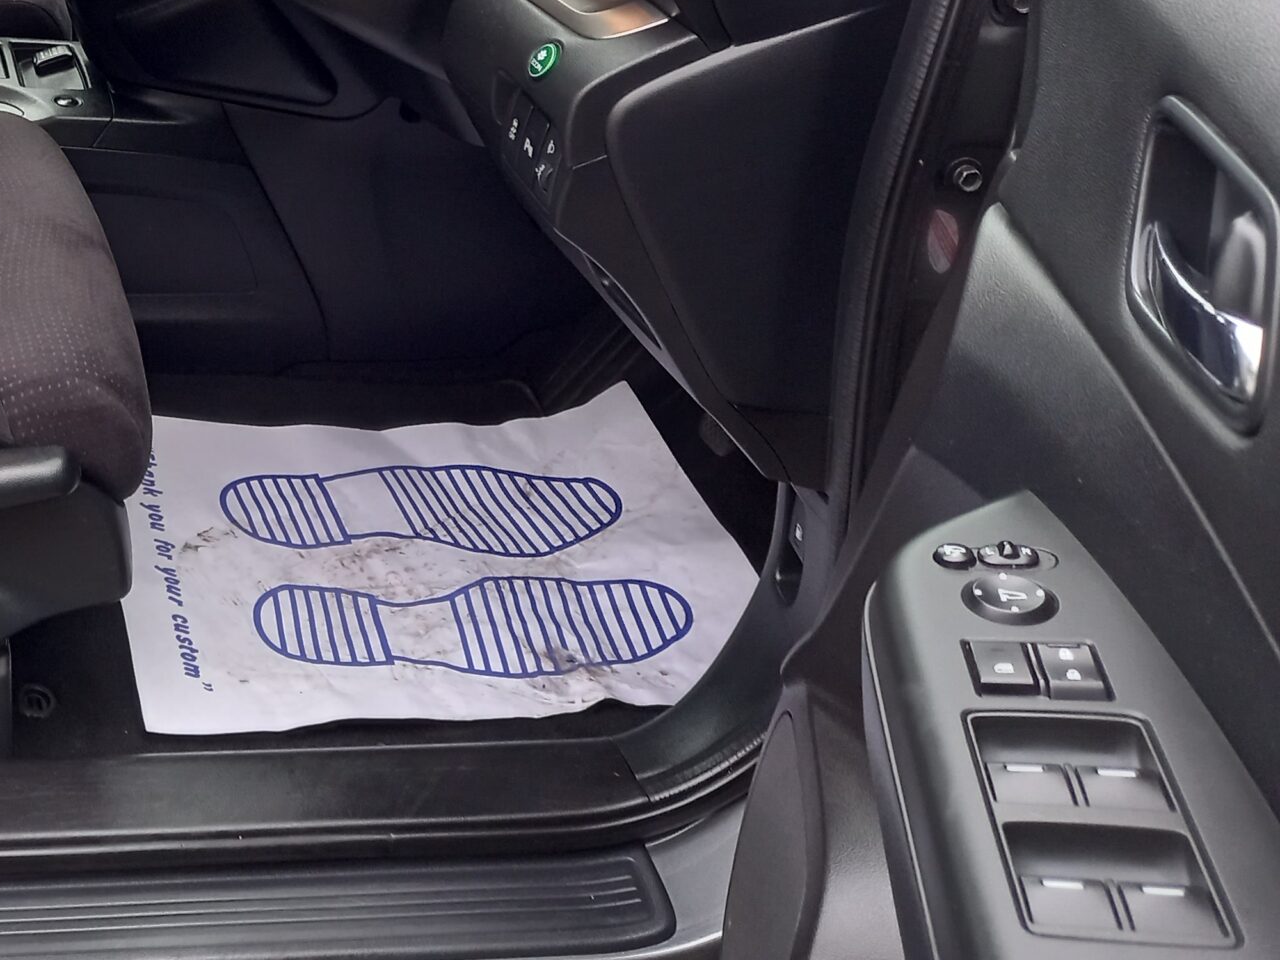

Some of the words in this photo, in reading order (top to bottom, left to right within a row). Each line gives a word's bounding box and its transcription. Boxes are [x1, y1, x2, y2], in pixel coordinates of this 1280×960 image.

[139, 501, 165, 531] you
[153, 538, 176, 560] for
[154, 564, 183, 607] your
[171, 613, 201, 678] custom
